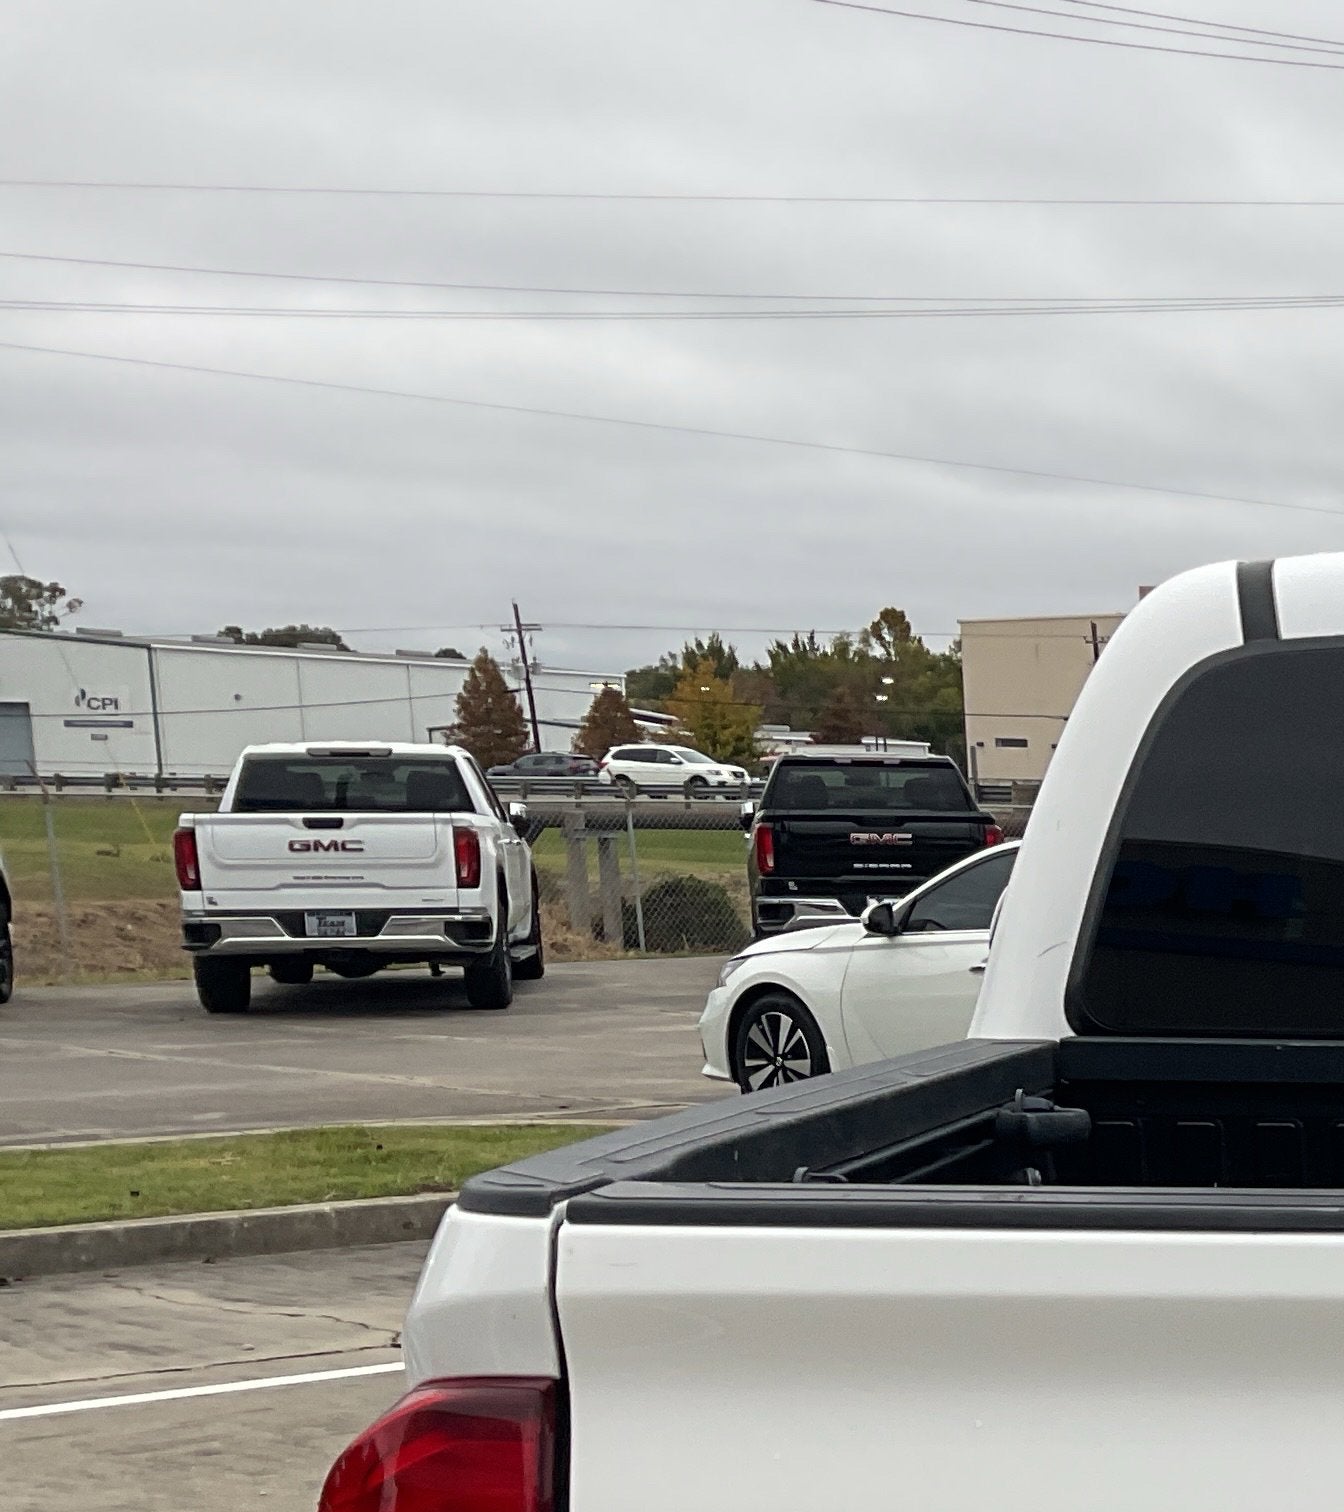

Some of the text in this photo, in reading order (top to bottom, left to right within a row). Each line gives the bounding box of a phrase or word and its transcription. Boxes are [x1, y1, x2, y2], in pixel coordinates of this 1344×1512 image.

[87, 697, 119, 710] CPI
[288, 839, 365, 852] GMC
[850, 833, 913, 846] GMC
